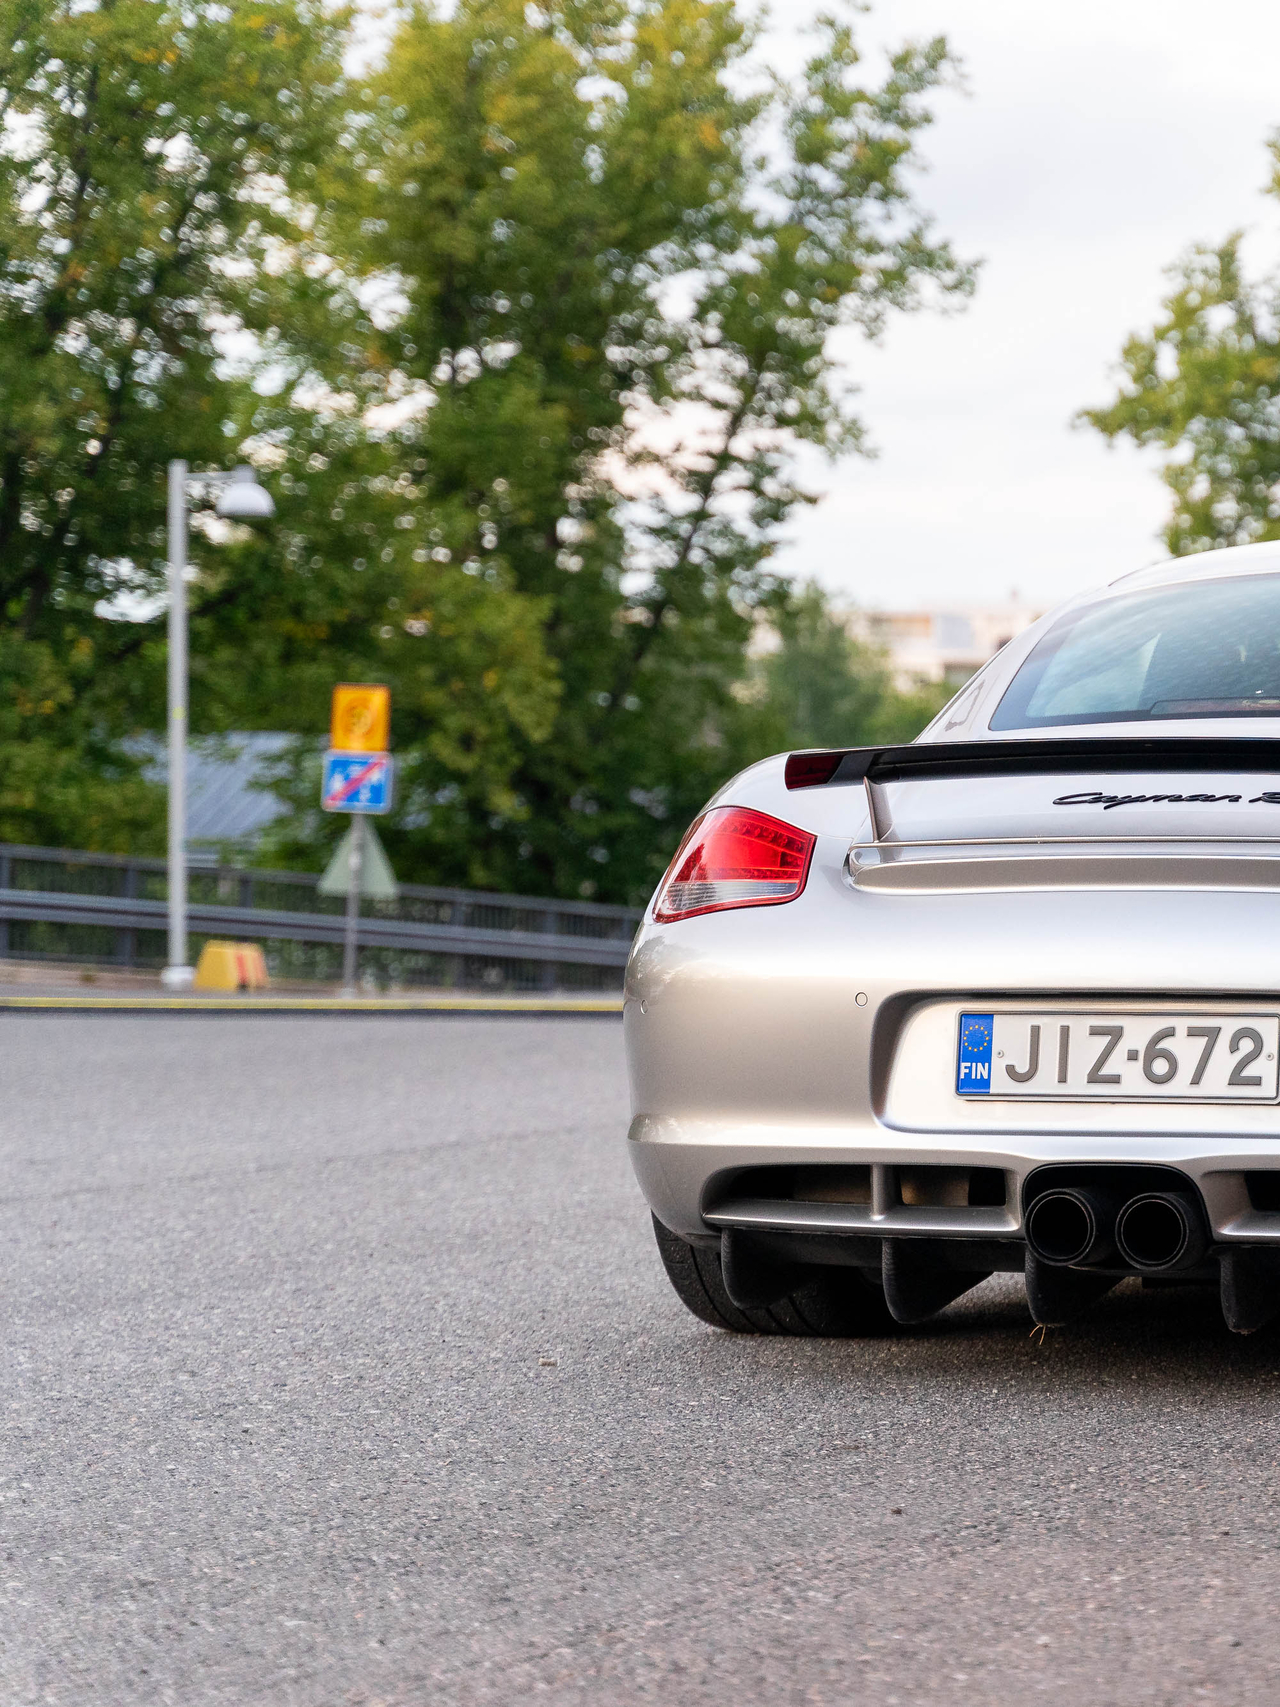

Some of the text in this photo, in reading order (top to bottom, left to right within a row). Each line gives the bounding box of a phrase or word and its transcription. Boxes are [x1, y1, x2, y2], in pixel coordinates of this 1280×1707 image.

[1053, 792, 1242, 810] Cayman
[1005, 1024, 1264, 1086] JIZ-672
[960, 1062, 989, 1080] FIN
